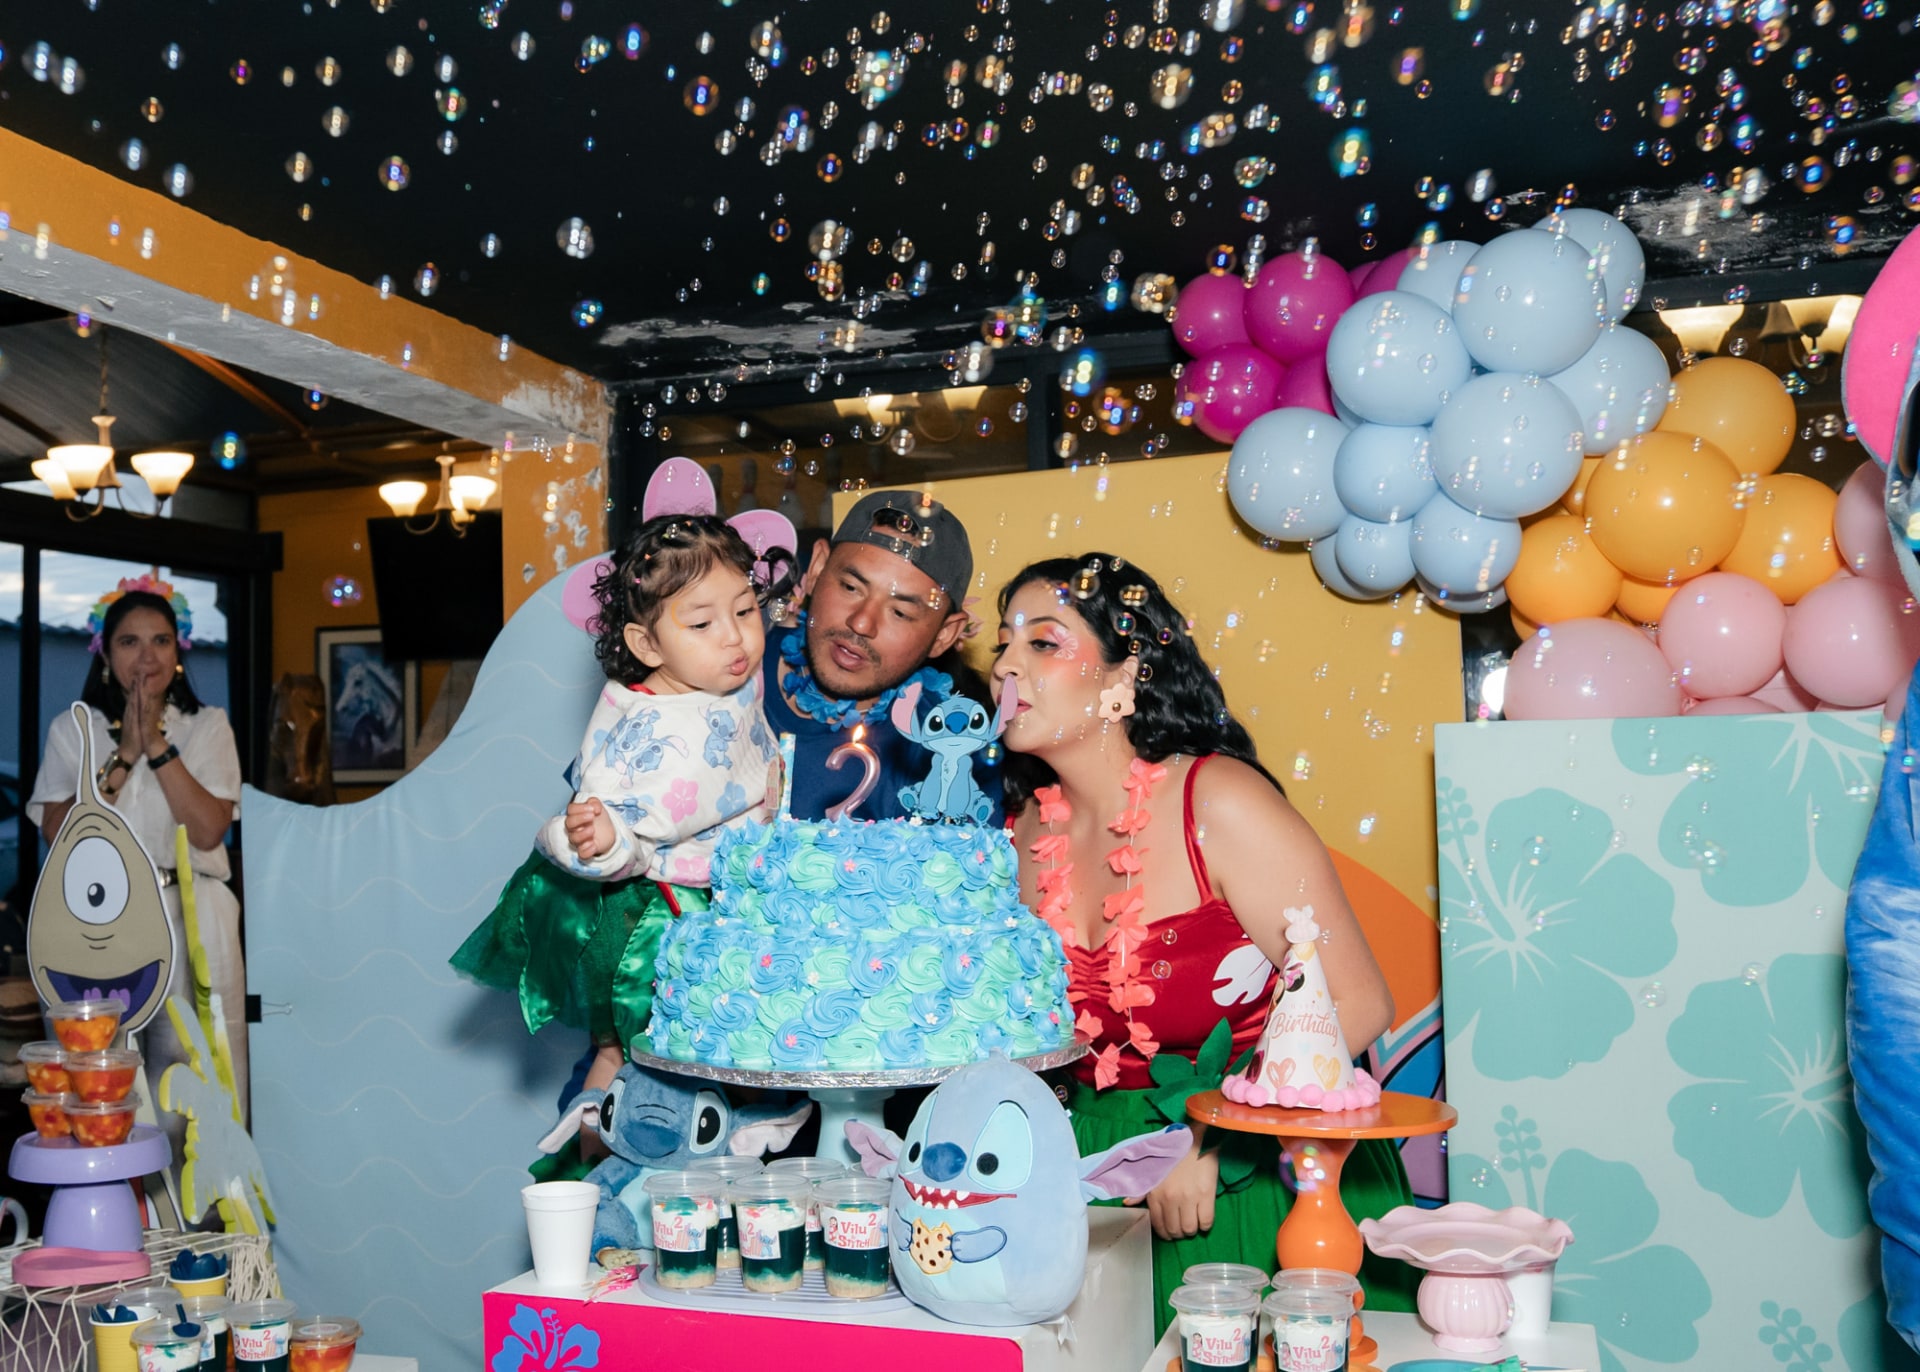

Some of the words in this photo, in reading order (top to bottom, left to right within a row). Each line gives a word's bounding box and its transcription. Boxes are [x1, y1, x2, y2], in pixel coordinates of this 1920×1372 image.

[1270, 1011, 1338, 1047] Birthday
[674, 1216, 683, 1229] 2
[747, 1222, 755, 1235] 2
[841, 1221, 867, 1234] Vilu
[868, 1213, 877, 1226] 2
[242, 1337, 263, 1348] Vilu
[264, 1330, 271, 1341] 2
[1206, 1338, 1232, 1350] Vilu
[1233, 1328, 1241, 1341] 2
[1293, 1346, 1321, 1359] Vilu
[1321, 1336, 1329, 1349] 2
